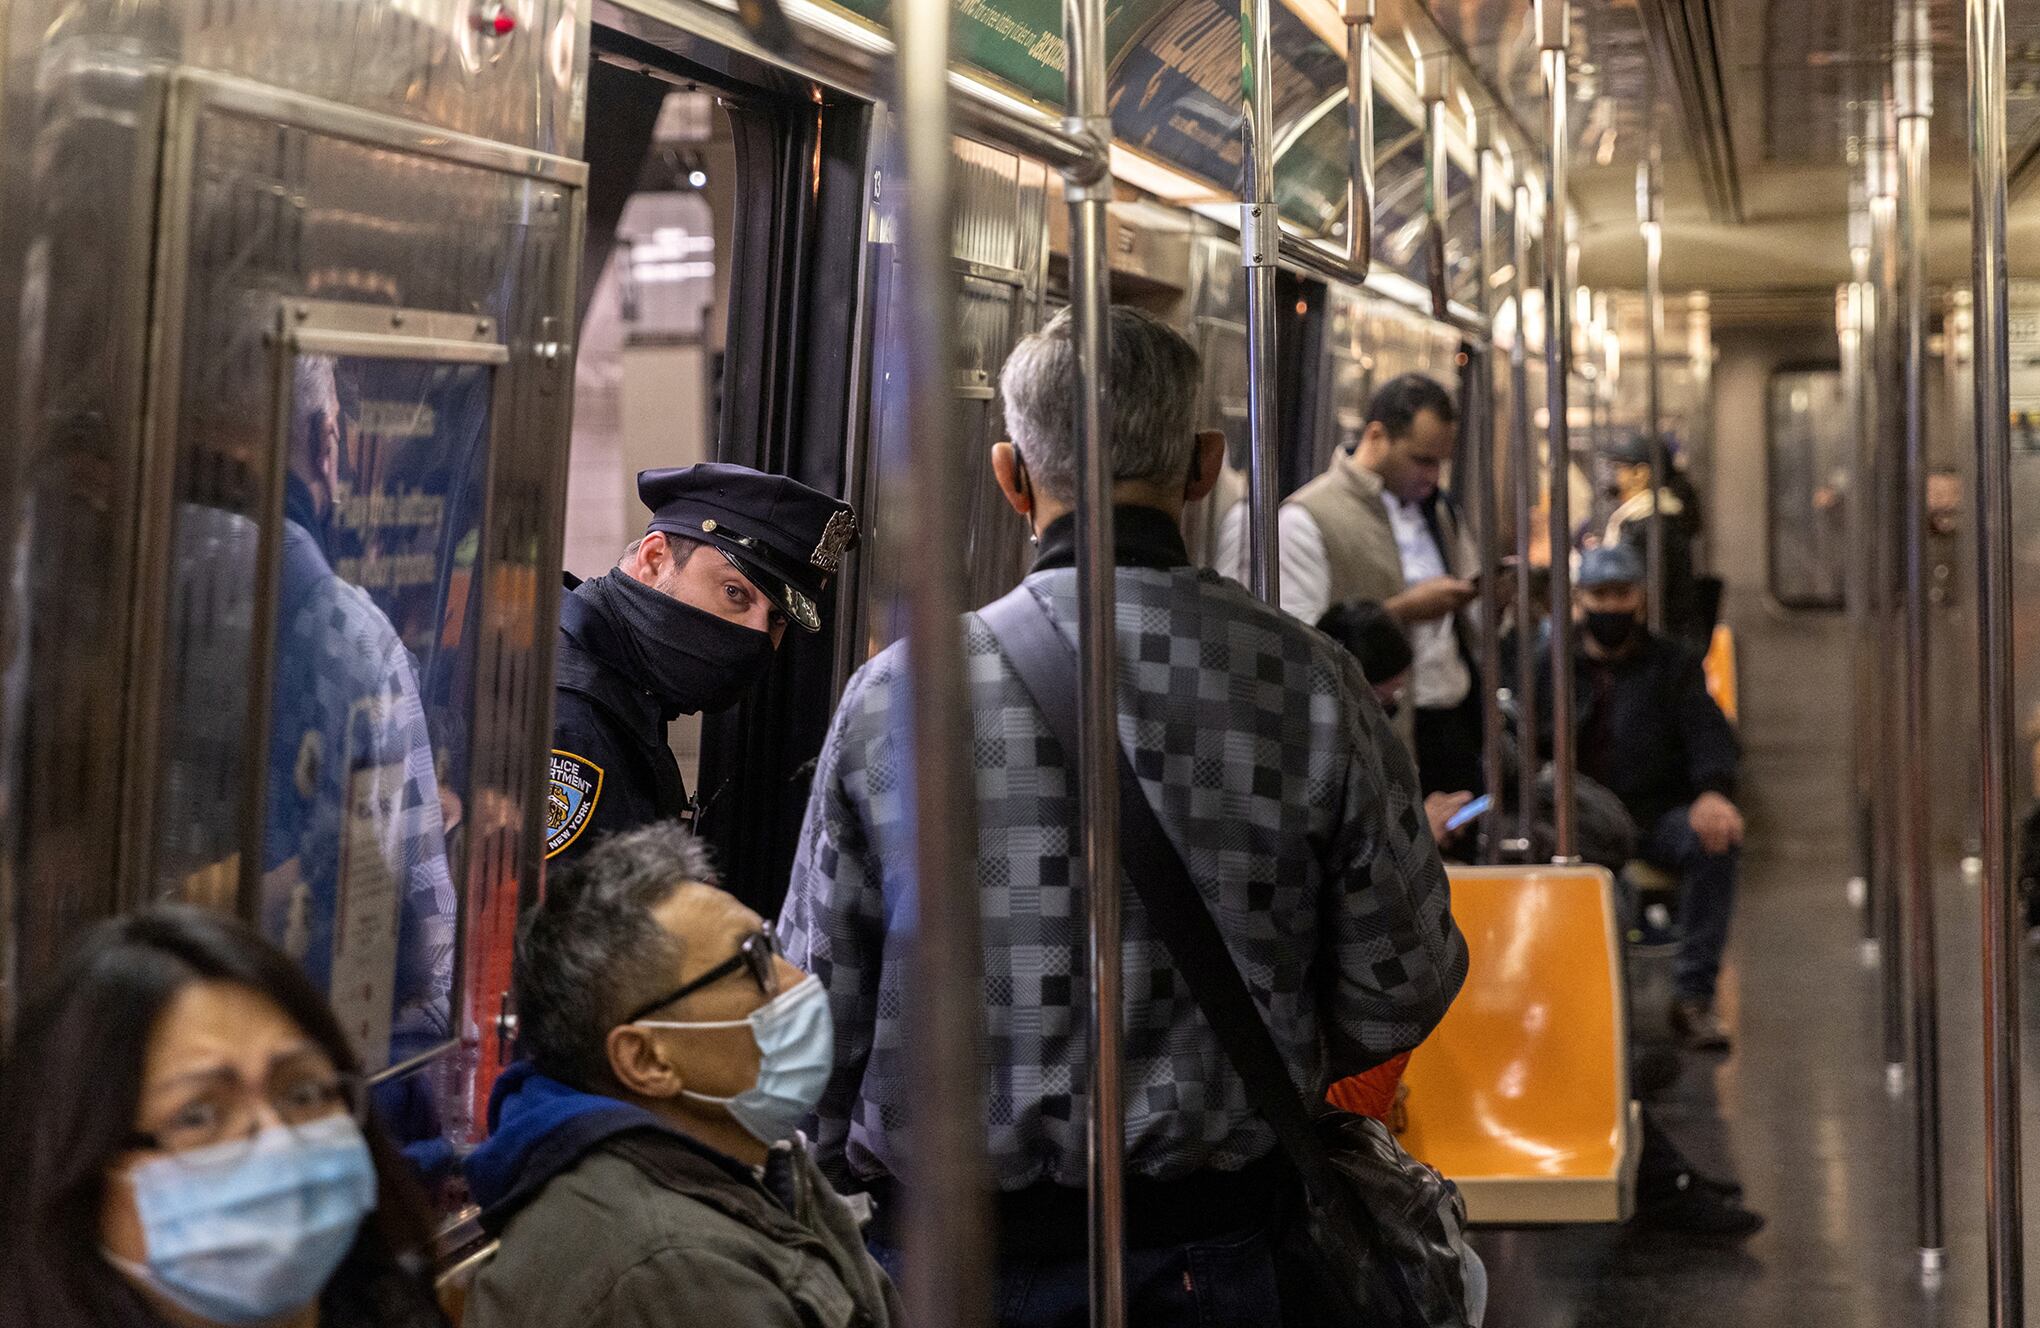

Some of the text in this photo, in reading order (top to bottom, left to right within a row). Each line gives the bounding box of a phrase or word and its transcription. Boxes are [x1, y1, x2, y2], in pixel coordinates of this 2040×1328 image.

[995, 12, 1017, 40] lottery
[1010, 21, 1032, 45] ticket
[548, 800, 591, 850] NEW YORK
